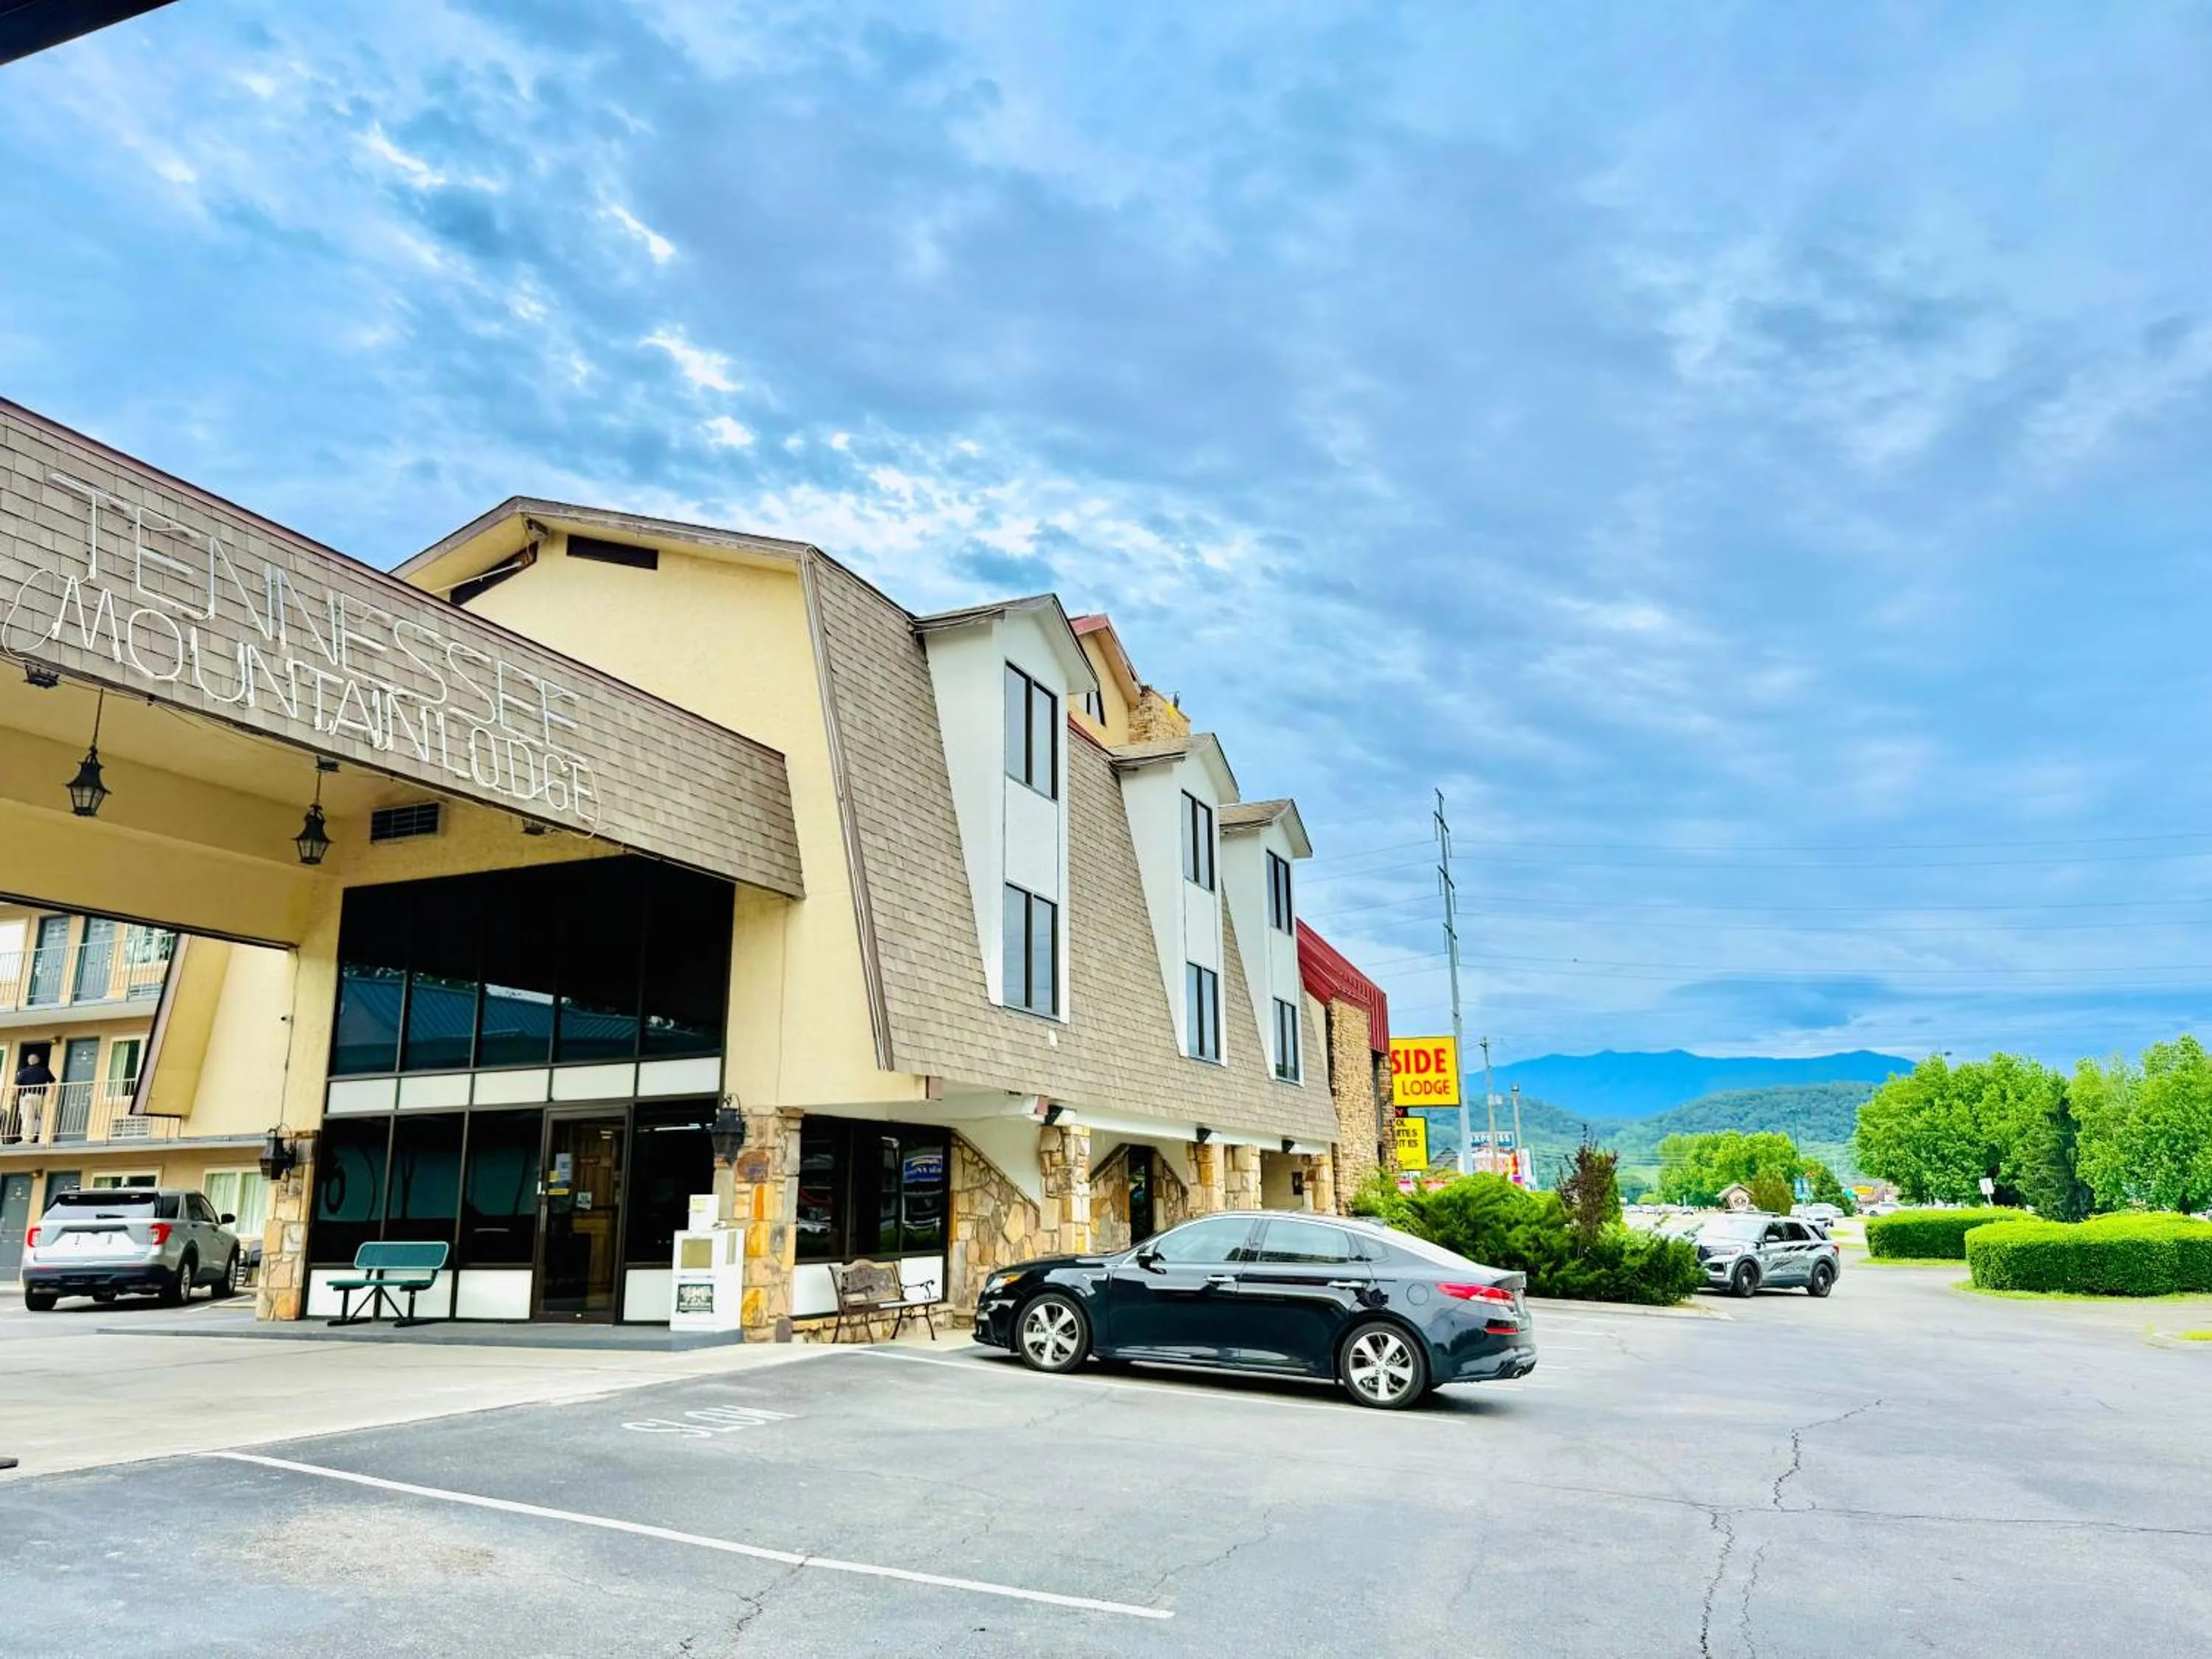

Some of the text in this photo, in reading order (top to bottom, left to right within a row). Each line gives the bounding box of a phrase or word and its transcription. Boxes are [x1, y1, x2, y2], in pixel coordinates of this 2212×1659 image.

[49, 472, 588, 763] TENNESSEE
[50, 574, 596, 821] MOUNTAIN LODGE
[1402, 1079, 1450, 1096] LODGE
[621, 1404, 797, 1438] SLOW
